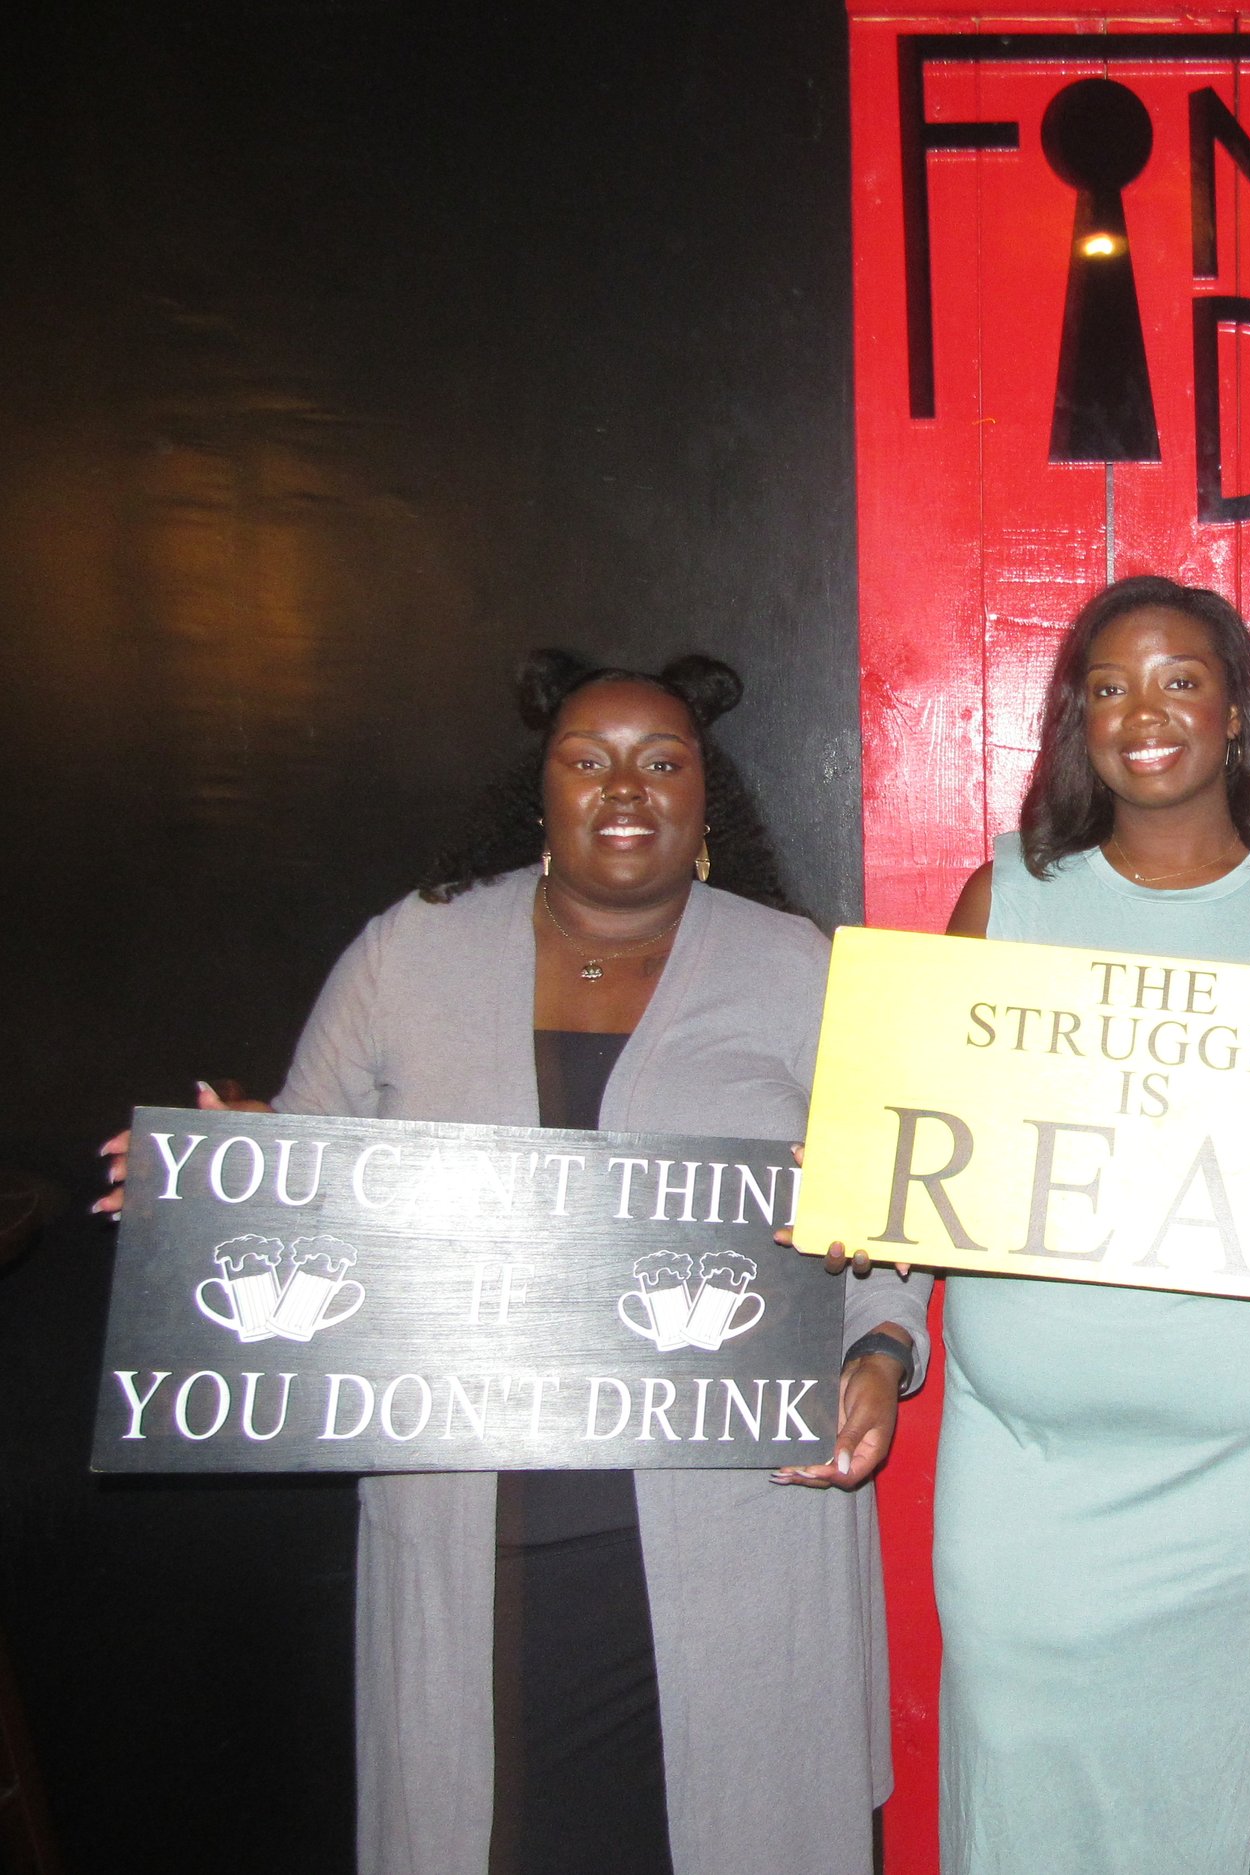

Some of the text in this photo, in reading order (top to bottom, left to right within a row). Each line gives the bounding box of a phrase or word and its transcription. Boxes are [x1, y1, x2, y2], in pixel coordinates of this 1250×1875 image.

[1091, 961, 1218, 1016] THE
[1114, 1070, 1171, 1118] IS
[150, 1132, 332, 1206] YOU
[466, 1262, 535, 1326] IF
[114, 1370, 821, 1441] YOU DON'T DRINK
